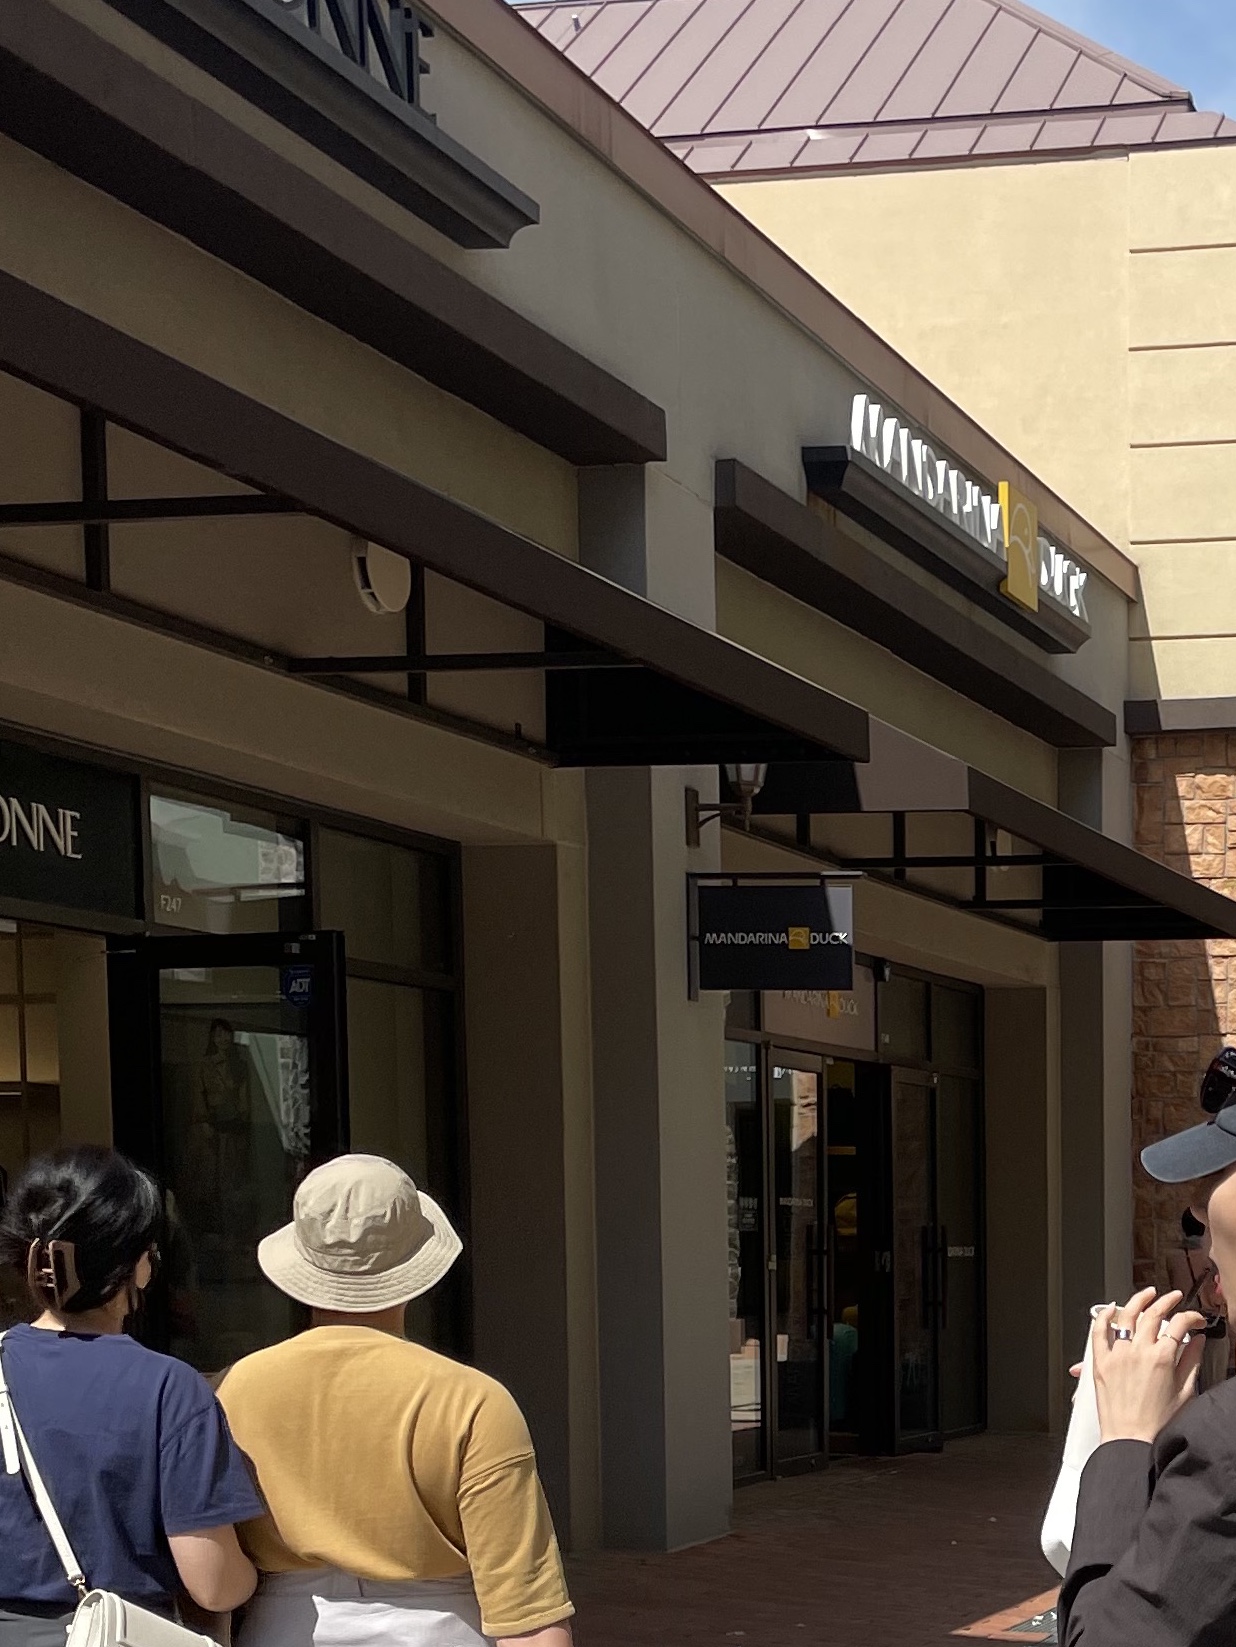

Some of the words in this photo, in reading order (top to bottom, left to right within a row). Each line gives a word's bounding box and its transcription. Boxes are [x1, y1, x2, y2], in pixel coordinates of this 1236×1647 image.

[160, 894, 183, 913] F247
[704, 932, 789, 945] MANDARINA
[809, 932, 849, 945] DUCK
[289, 977, 311, 993] ADT
